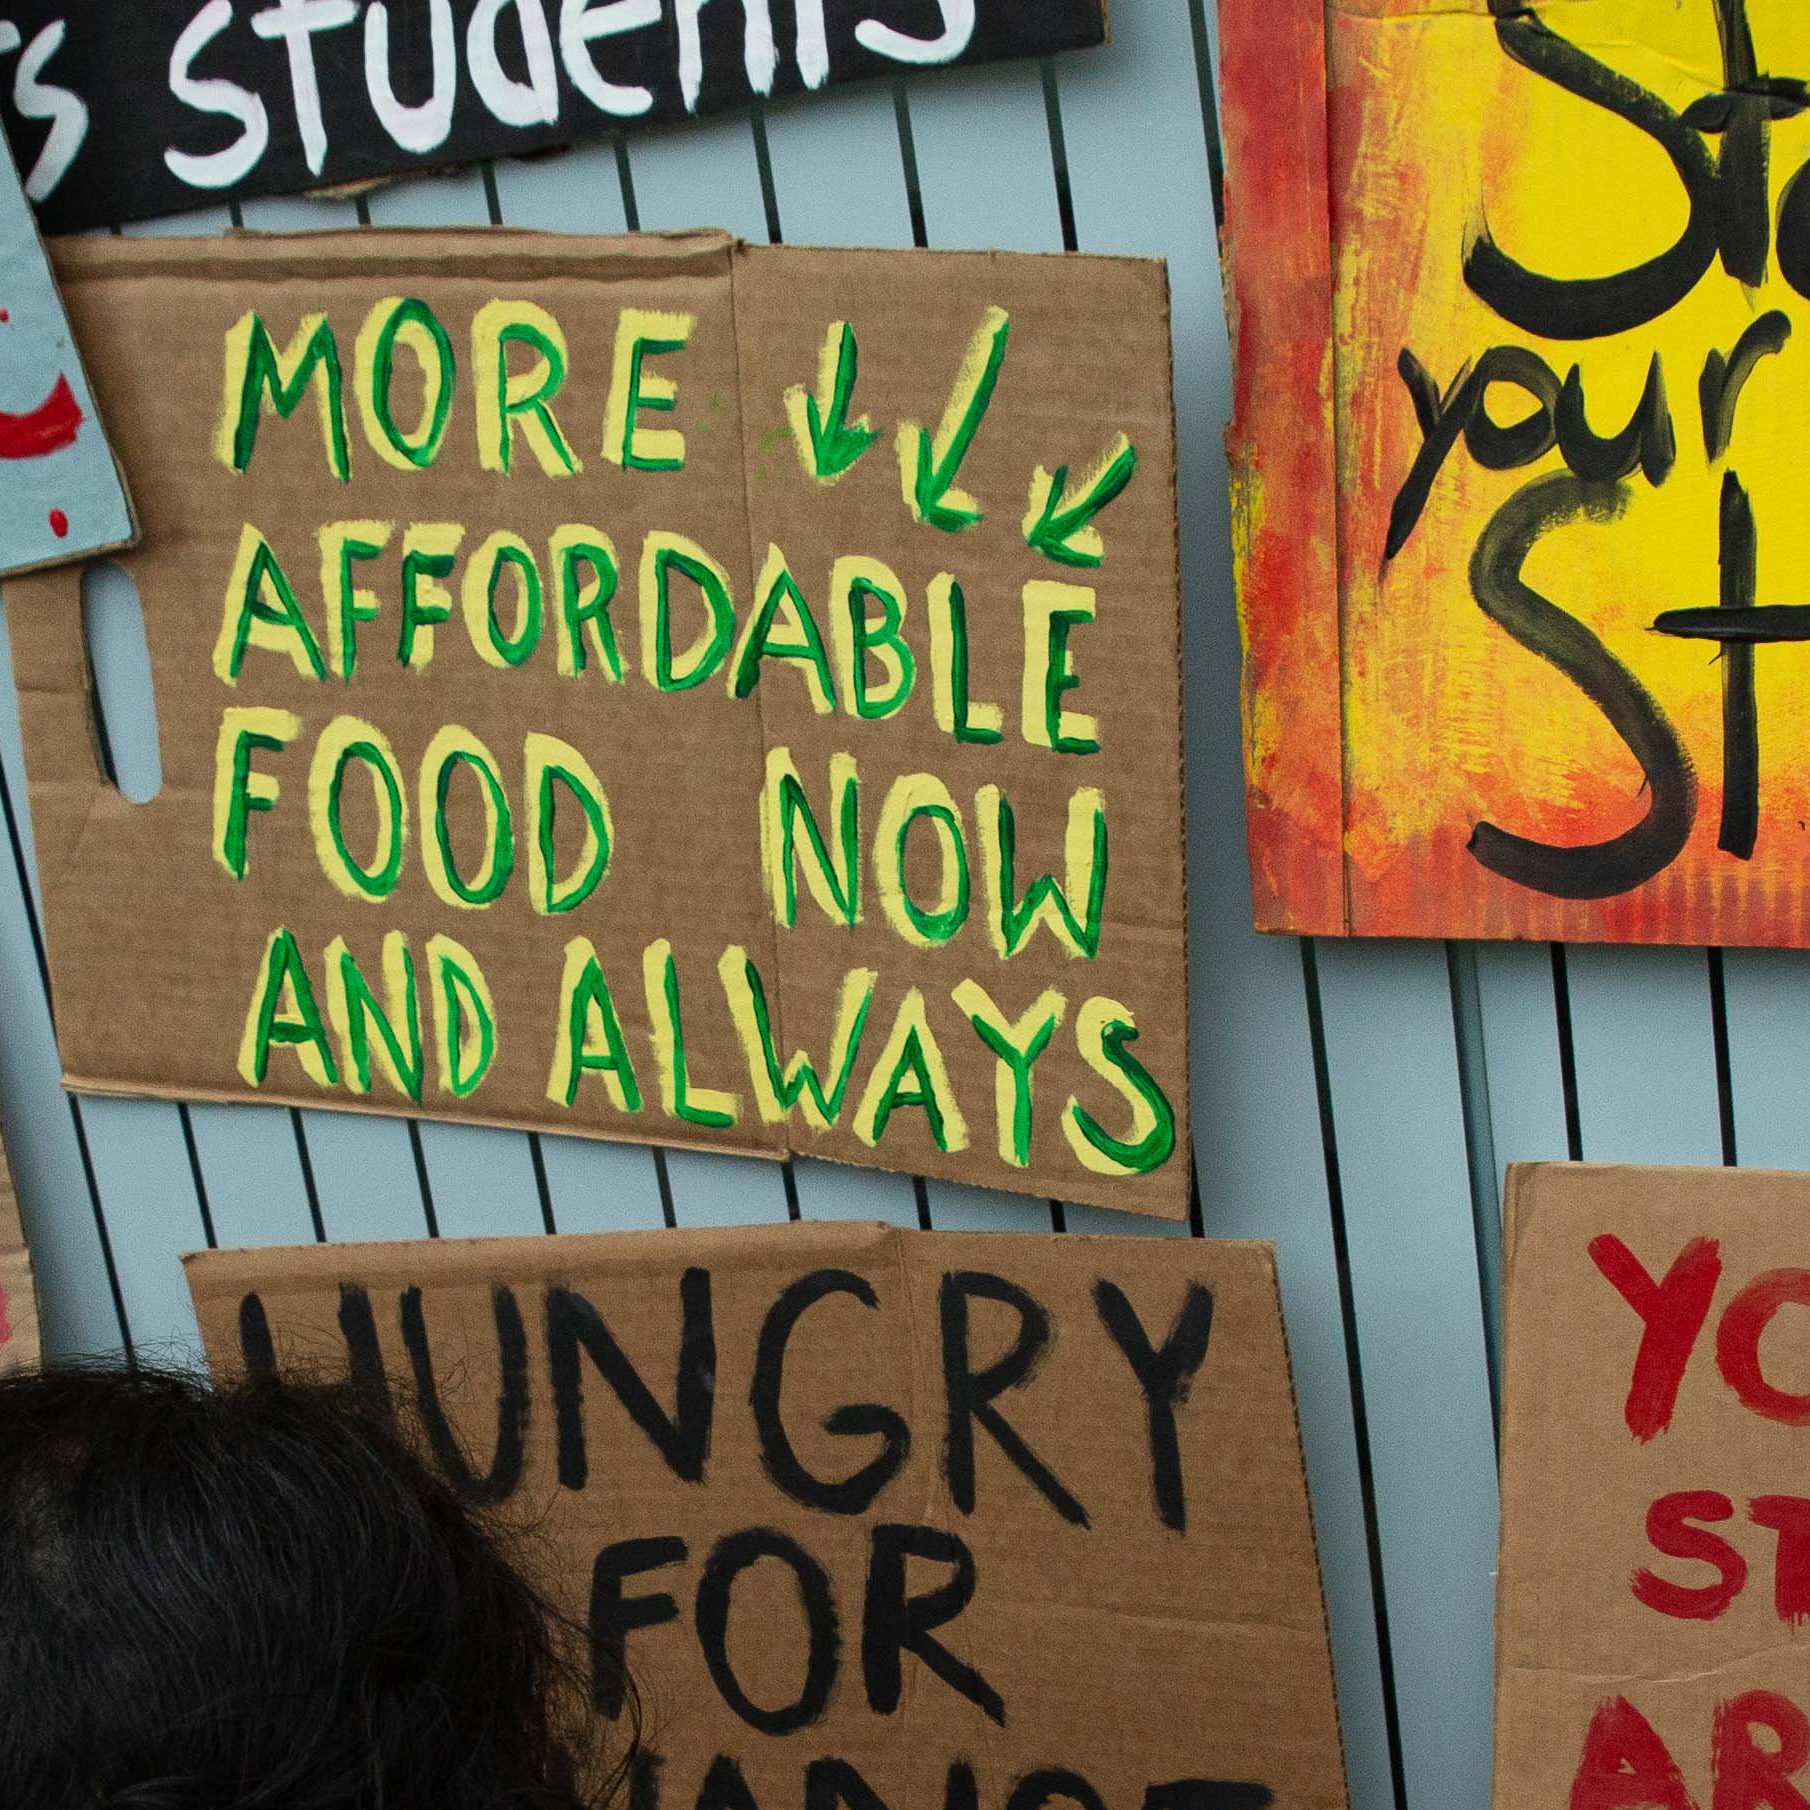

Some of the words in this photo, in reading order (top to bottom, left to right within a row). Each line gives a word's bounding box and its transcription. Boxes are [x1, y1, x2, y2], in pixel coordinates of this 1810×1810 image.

[215, 295, 700, 480] MORE
[1381, 309, 1791, 567] your
[213, 516, 1103, 755] AFFORDABLE
[214, 705, 614, 914] FOOD
[761, 746, 1106, 962] NOW
[237, 925, 494, 1105] AND
[547, 936, 1177, 1179] ALWAYS
[592, 1524, 1005, 1736] FOR
